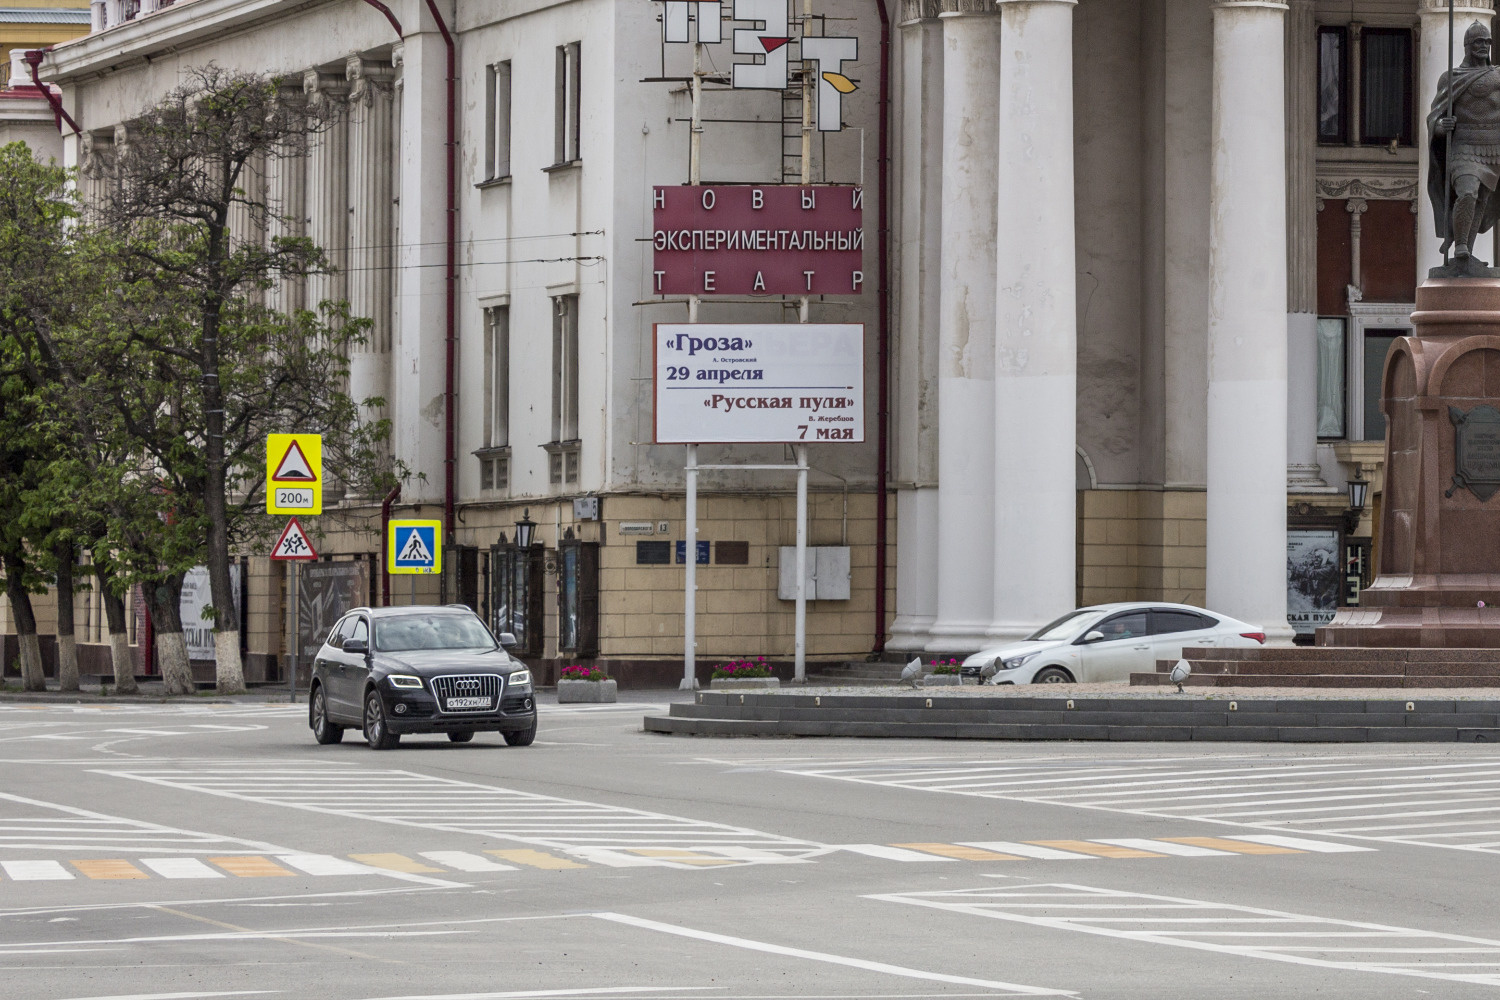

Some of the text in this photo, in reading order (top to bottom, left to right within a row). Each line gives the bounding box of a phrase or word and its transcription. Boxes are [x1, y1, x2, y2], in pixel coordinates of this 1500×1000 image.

[653, 188, 864, 210] НОВЫЙ
[654, 227, 864, 251] ЭКСПЕРИМЕНТАЛЬНЫЙ
[654, 271, 864, 291] ТЕАТР
[666, 333, 753, 356] «Гроза»
[666, 366, 764, 384] 29 апреля
[704, 394, 854, 412] «Русская пуля»
[817, 415, 854, 423] Жеребцов
[797, 425, 854, 440] 7 мая
[660, 523, 668, 532] 13
